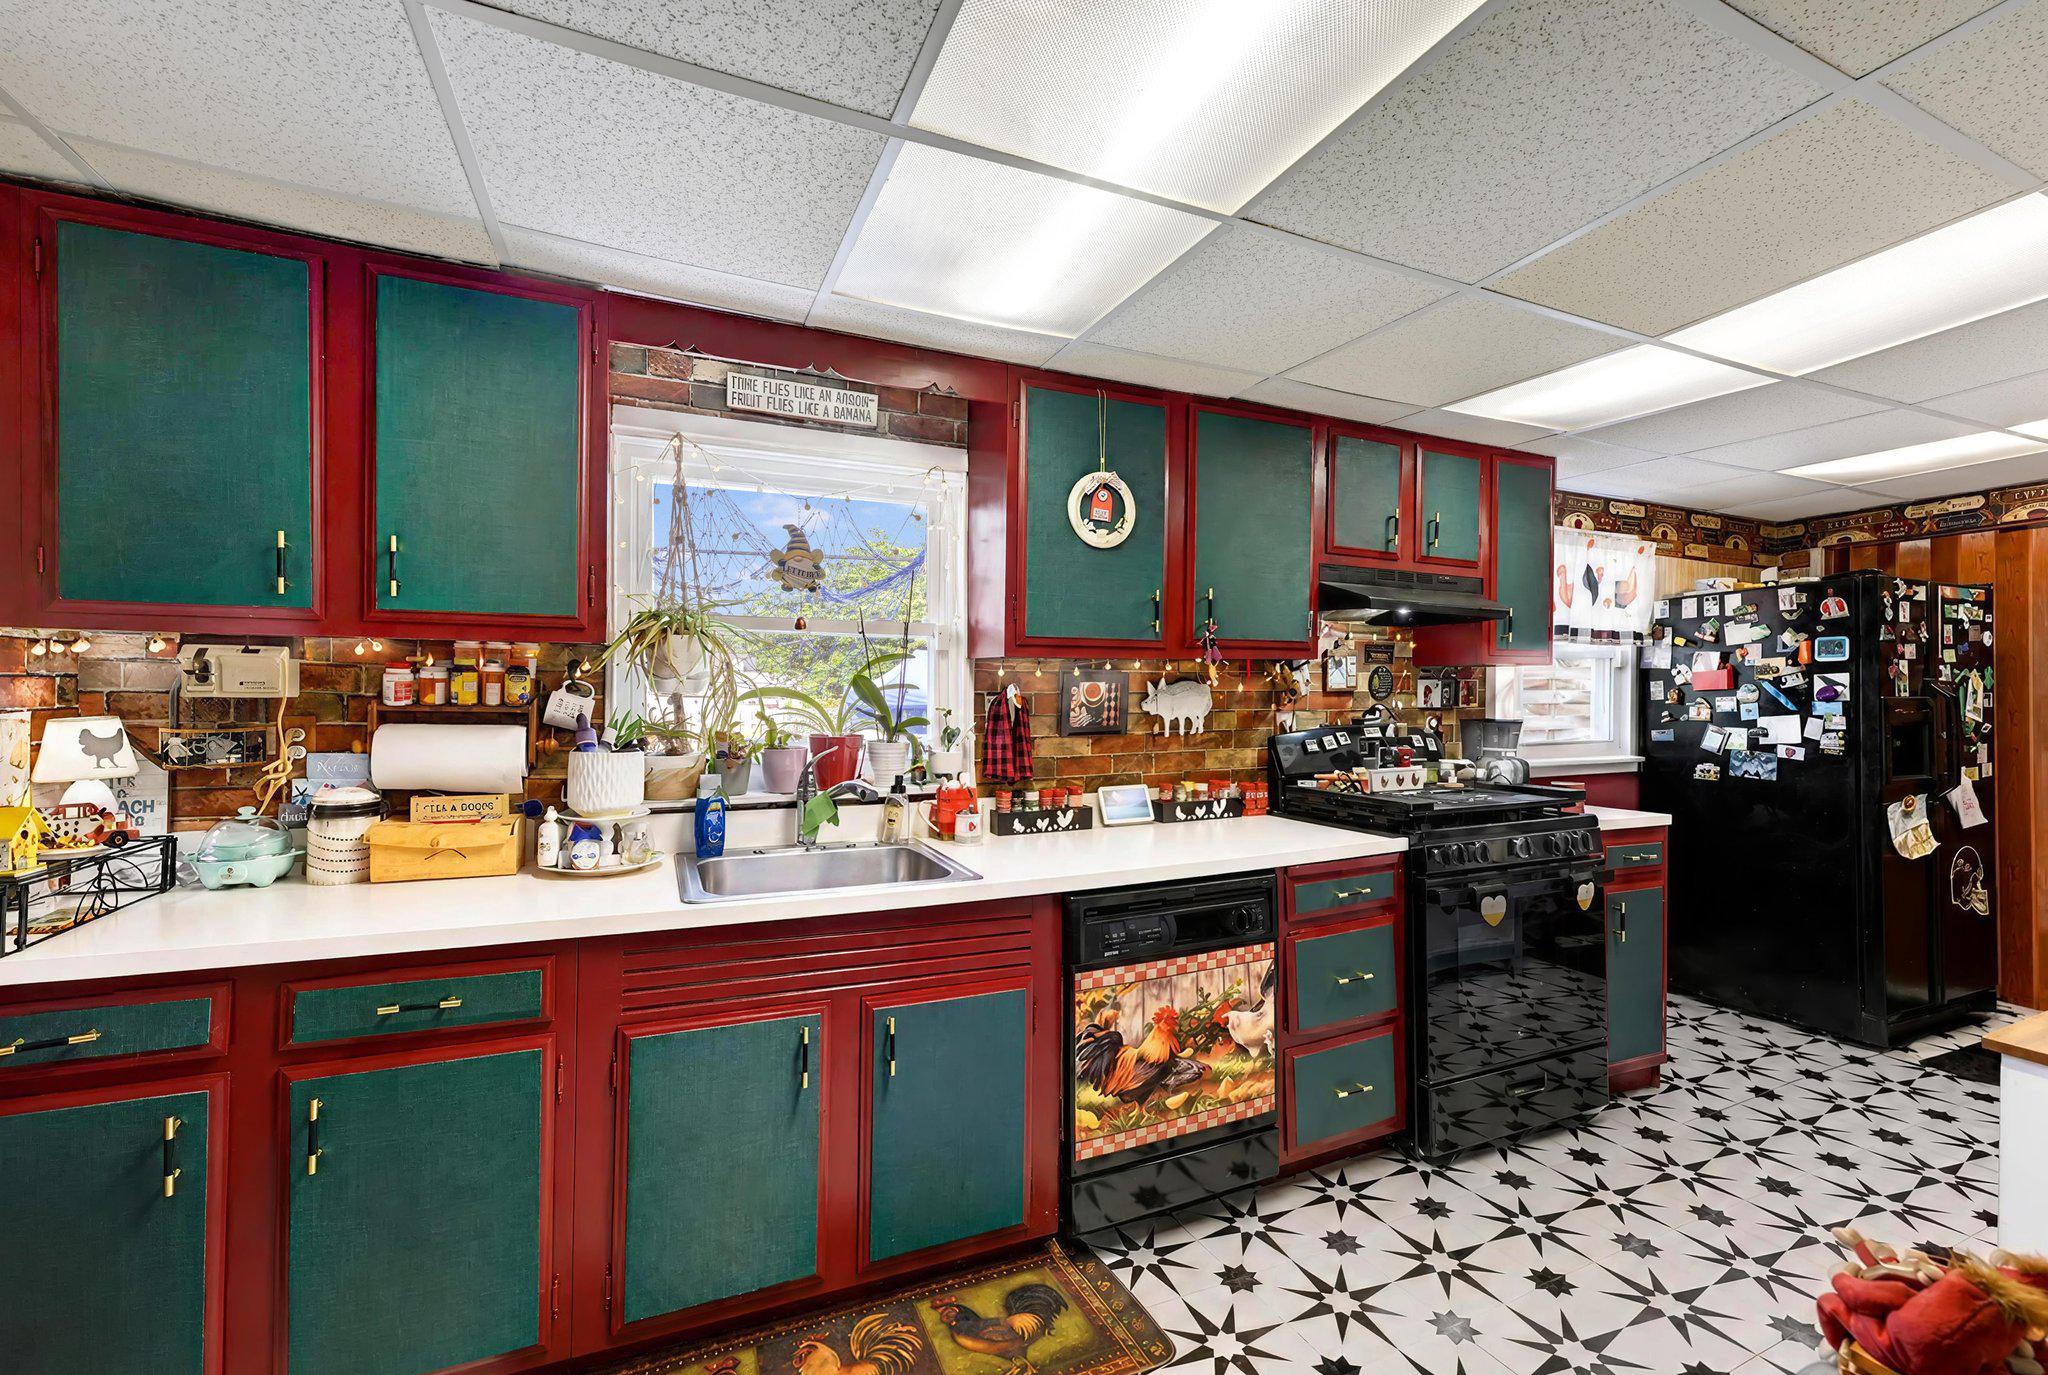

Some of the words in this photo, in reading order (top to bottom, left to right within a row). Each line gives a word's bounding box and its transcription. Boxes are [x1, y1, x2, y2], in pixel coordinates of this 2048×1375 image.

[819, 389, 832, 402] AN
[798, 400, 819, 416] LIKE
[823, 405, 830, 418] A
